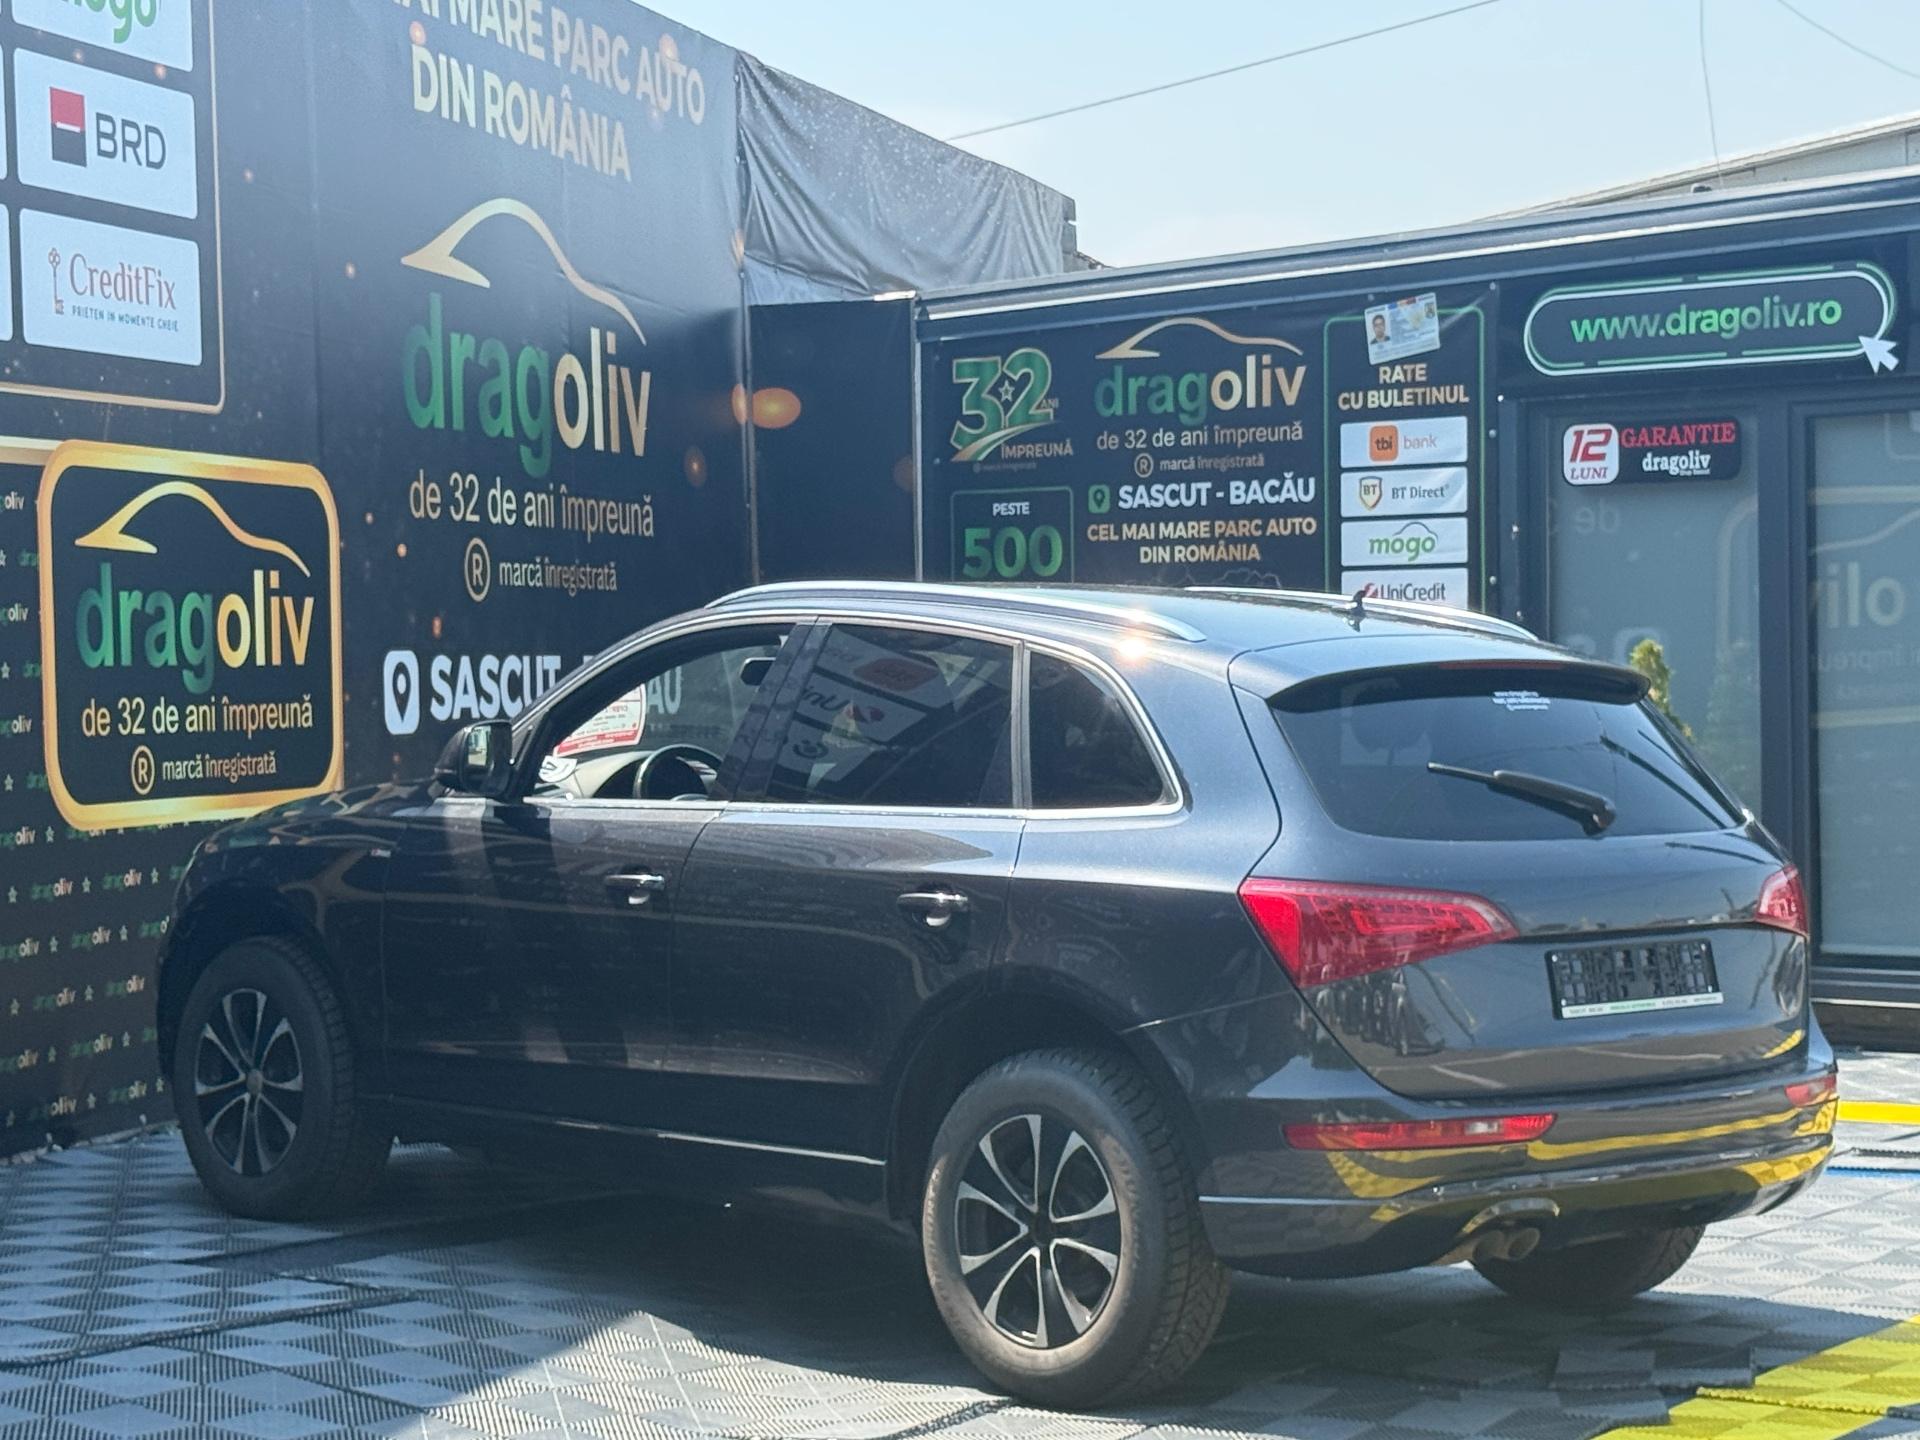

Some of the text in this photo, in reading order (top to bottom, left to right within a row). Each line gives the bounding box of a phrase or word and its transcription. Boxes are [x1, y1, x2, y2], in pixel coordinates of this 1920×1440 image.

[62, 0, 157, 43] go
[450, 0, 705, 126] MARE PARC AUTO
[412, 44, 631, 182] DIN ROMÂNIA
[95, 112, 167, 170] BRD
[69, 252, 176, 310] CreditFix
[1570, 295, 1842, 342] www.dragoliv.ro
[403, 293, 652, 478] dragoliv
[1379, 363, 1427, 384] RATE
[950, 347, 1053, 450] 32
[1094, 354, 1307, 427] dragoliv
[1338, 384, 1470, 410] CU BULETINUL
[1000, 438, 1074, 459] ÎMPREUNĂ
[1097, 421, 1303, 449] de 32 de ani împreună
[1375, 433, 1438, 451] tbi bank
[1570, 429, 1613, 463] 12
[1620, 422, 1736, 448] GARANTIE
[1160, 456, 1195, 472] marcă
[1570, 467, 1608, 480] LUNI
[1642, 450, 1711, 475] dragoliv
[410, 469, 654, 543] de 32 de ani împreună
[1118, 481, 1212, 509] SASCUT
[1229, 471, 1316, 505] BACĂU
[1363, 484, 1377, 496] BT
[1391, 486, 1407, 499] BT
[992, 502, 1030, 517] PESTE
[1087, 516, 1317, 541] CEL MAI MARE PARC AUTO
[962, 524, 1063, 579] 500
[1139, 540, 1261, 564] DIN ROMÂNIA
[1368, 536, 1436, 561] mogo
[500, 556, 542, 587] marcă
[545, 556, 617, 597] înregistrată
[1380, 583, 1446, 600] UniCredit
[75, 562, 315, 693] dragoliv
[430, 654, 561, 722] SASCUT
[82, 693, 313, 740] de 32 de ani împreună
[162, 754, 203, 781] marcă
[205, 751, 276, 783] înregistrată
